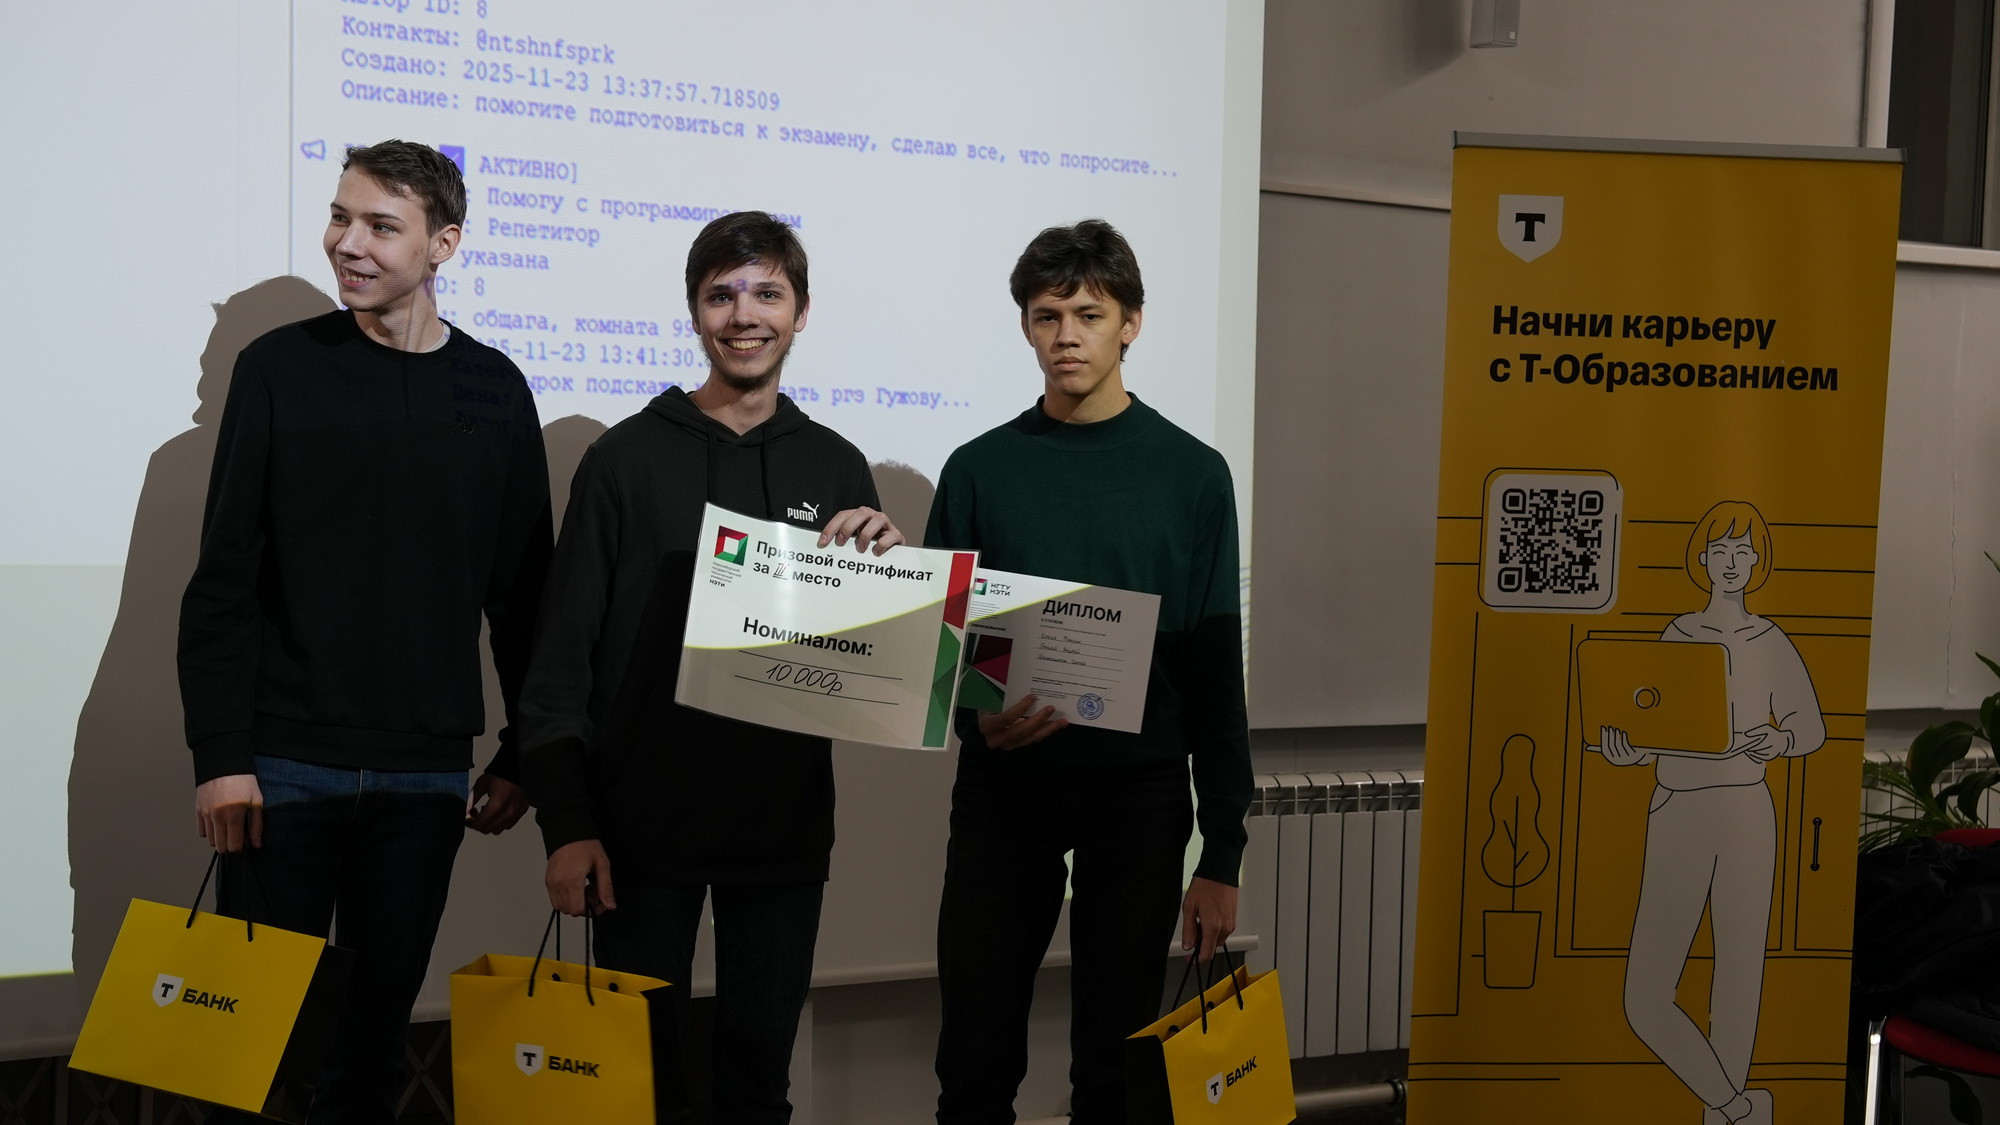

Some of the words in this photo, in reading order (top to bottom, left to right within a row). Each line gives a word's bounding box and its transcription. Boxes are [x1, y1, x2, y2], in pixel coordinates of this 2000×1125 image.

[476, 0, 488, 18] 8
[342, 15, 460, 46] Контакты:
[476, 29, 615, 66] @ntshnfsprk
[341, 47, 448, 77] Создано:
[463, 59, 590, 92] 2025-11-23
[603, 75, 780, 111] 13:37:57.718509
[341, 79, 460, 110] Описание:
[475, 95, 577, 121] помогите
[590, 105, 745, 137] подготовиться
[756, 125, 769, 140] к
[779, 125, 877, 152] экзамену,
[891, 135, 957, 158] сделаю
[966, 144, 1006, 164] все,
[1018, 148, 1050, 167] что
[1060, 151, 1178, 178] попросите...
[479, 157, 578, 184] АКТИВНО]
[487, 187, 564, 213] Помогу
[576, 198, 588, 212] с
[488, 218, 601, 247] Репетитор
[460, 249, 549, 269] указана
[474, 277, 486, 297] 8
[473, 309, 558, 333] общага,
[575, 317, 659, 337] комната
[1491, 305, 1613, 338] Начни
[1622, 312, 1776, 349] карьеру
[1489, 356, 1511, 382] с
[1519, 352, 1838, 392] Т-Образованием
[876, 387, 970, 409] Гужову...
[787, 507, 815, 522] PUMA
[756, 540, 835, 567] Призовой
[837, 556, 933, 583] сертификат
[753, 562, 770, 574] за
[792, 571, 841, 588] место
[990, 583, 1012, 591] НГТУ
[989, 589, 1011, 597] НЭТИ
[1042, 599, 1122, 623] ДИПЛОМ
[743, 617, 874, 656] Номиналом:
[766, 663, 792, 682] 10
[182, 988, 239, 1014] БАНК
[548, 1055, 600, 1078] БАНК
[1226, 1055, 1258, 1088] БАНК
